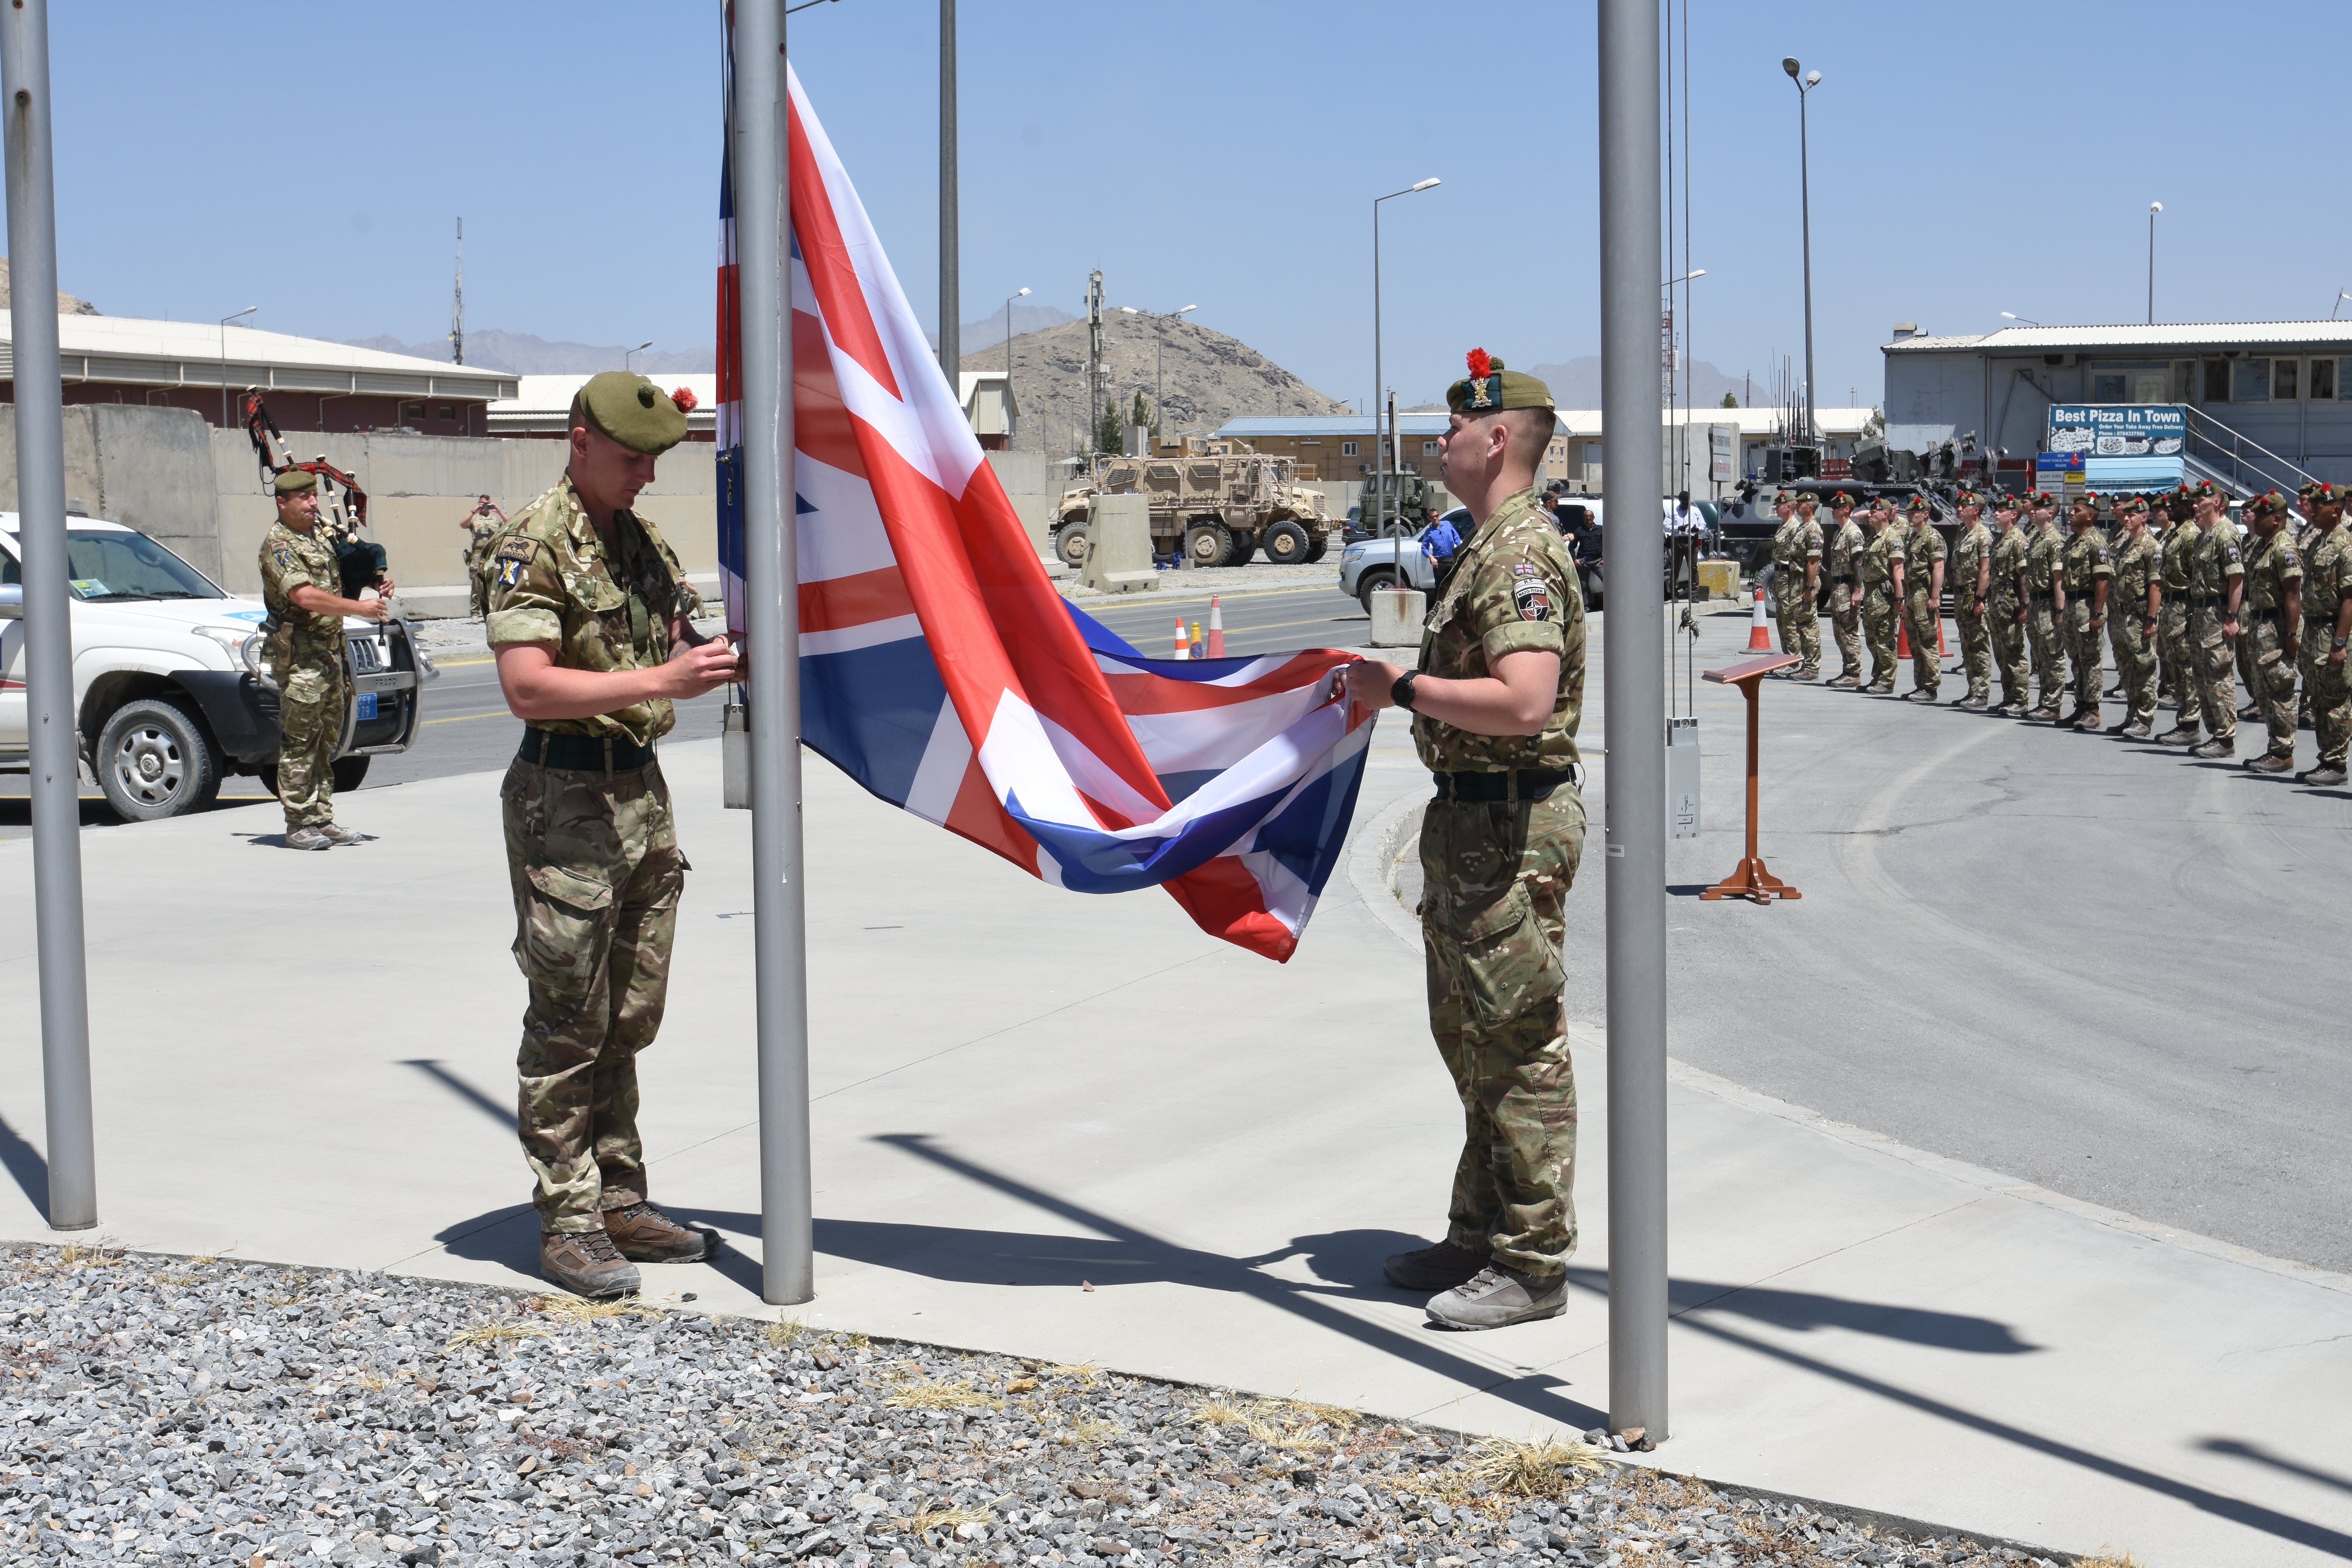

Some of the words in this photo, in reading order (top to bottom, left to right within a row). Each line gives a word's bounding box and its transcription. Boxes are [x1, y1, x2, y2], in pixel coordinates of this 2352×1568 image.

[2055, 409, 2085, 422] Best
[2089, 409, 2123, 422] Pizza
[2128, 410, 2140, 422] In
[2145, 410, 2180, 422] Town
[500, 551, 530, 561] AFGHANISTAN
[376, 677, 397, 686] PRADO
